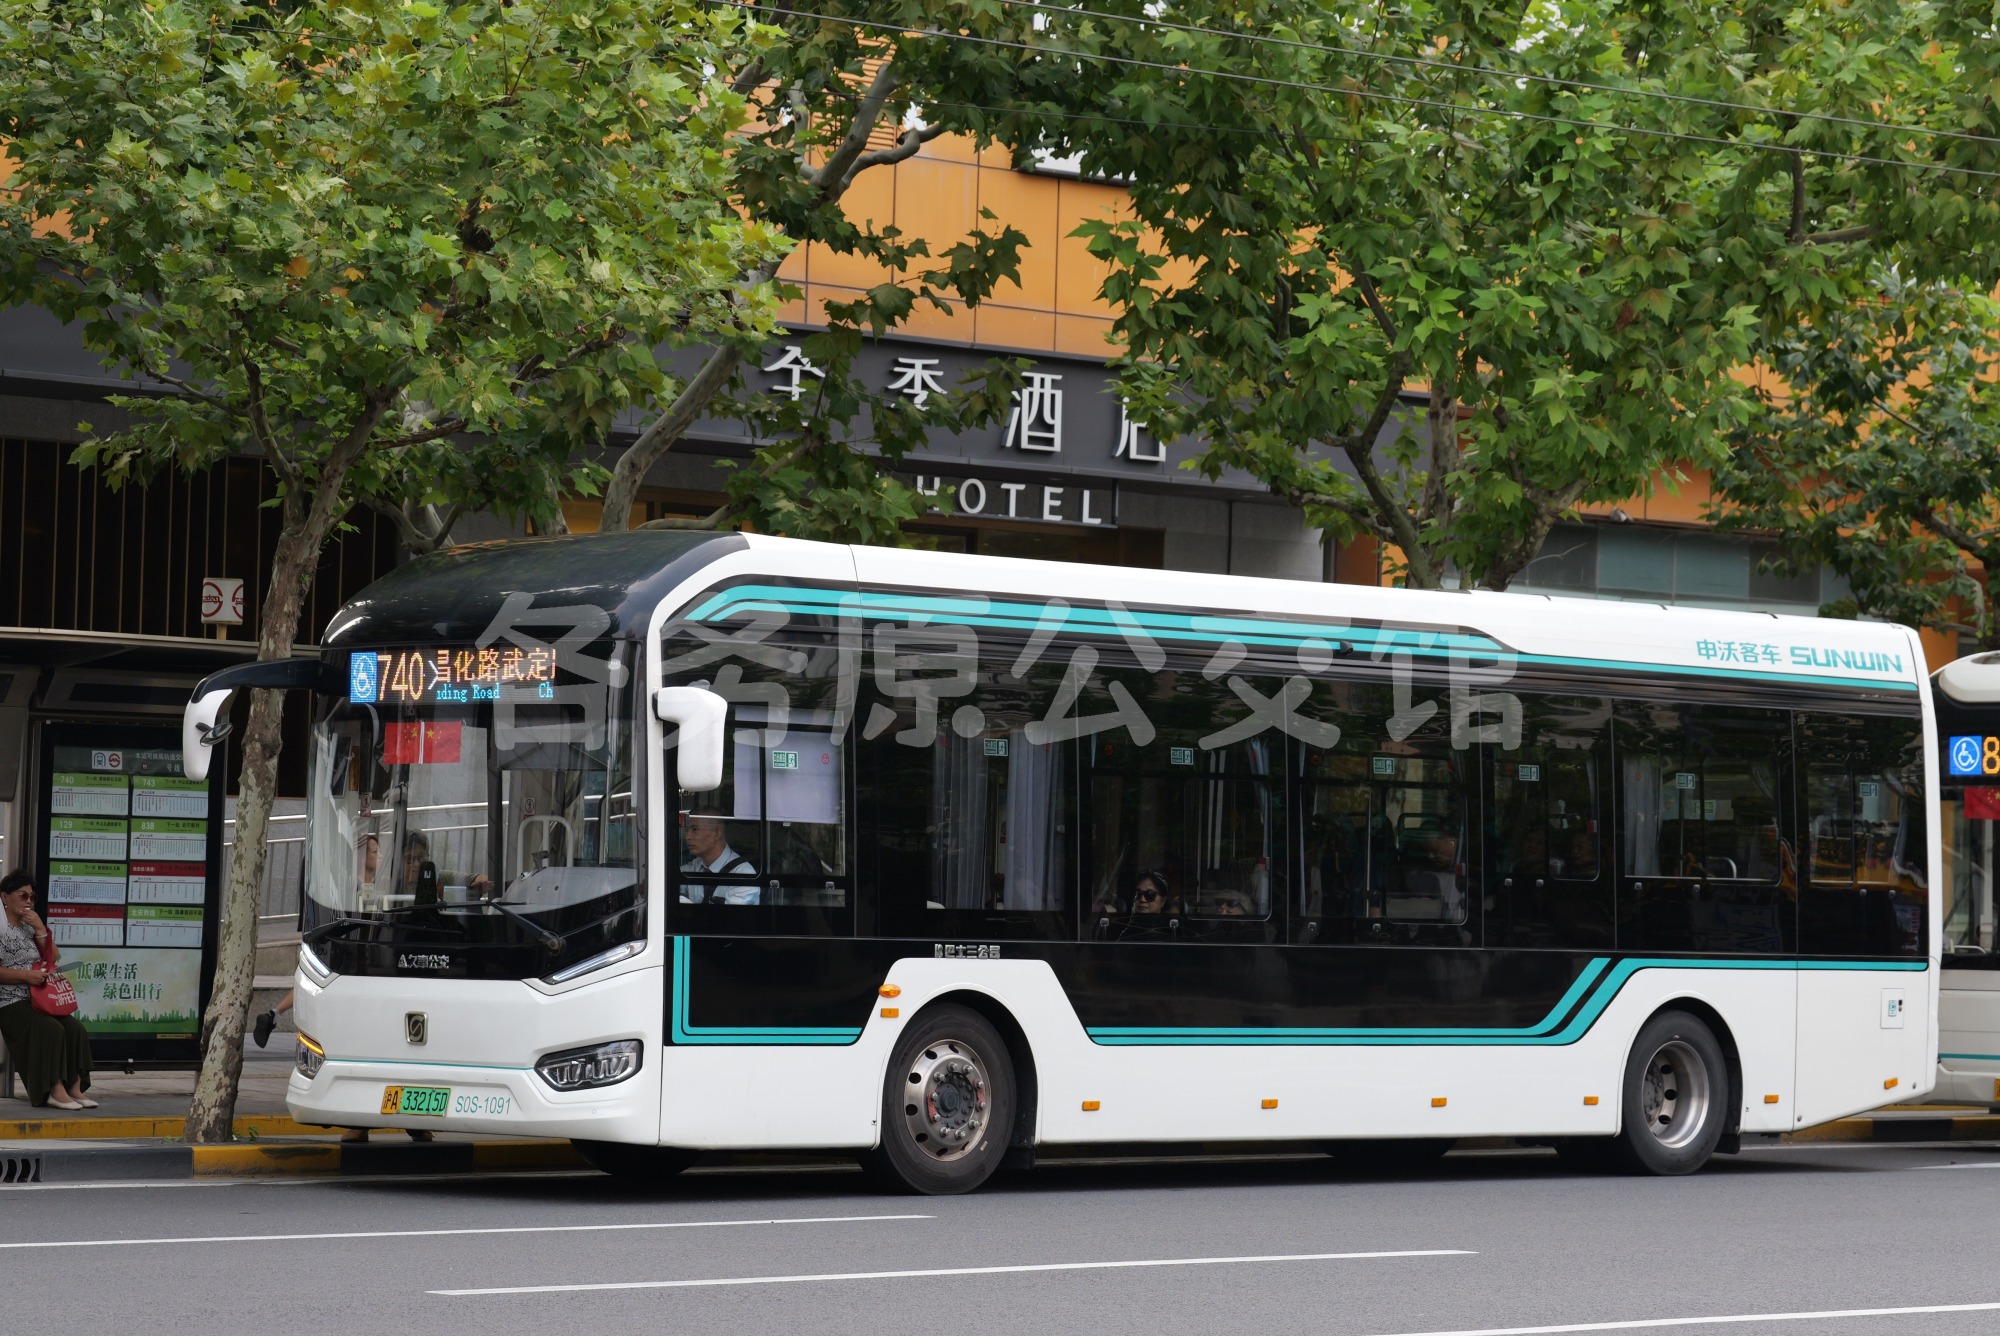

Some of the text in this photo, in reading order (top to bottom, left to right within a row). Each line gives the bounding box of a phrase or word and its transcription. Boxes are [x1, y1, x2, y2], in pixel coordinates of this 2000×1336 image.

[916, 474, 1102, 524] HOTEL
[437, 647, 556, 683] 昌化路武定
[1696, 639, 1903, 673] 申沃客车 SUNWIN
[377, 652, 424, 701] 740
[472, 682, 501, 700] Road
[538, 682, 554, 699] Ch
[135, 752, 183, 761] 本站可换乘轨道交
[60, 775, 74, 785] 740
[142, 778, 156, 788] 743
[59, 820, 73, 829] 129
[141, 821, 155, 831] 838
[59, 864, 73, 873] 923
[944, 944, 1001, 960] 巴士三公司
[76, 962, 138, 981] 低碳生活
[102, 982, 163, 1001] 绿色出行
[402, 1090, 448, 1112] 33215D
